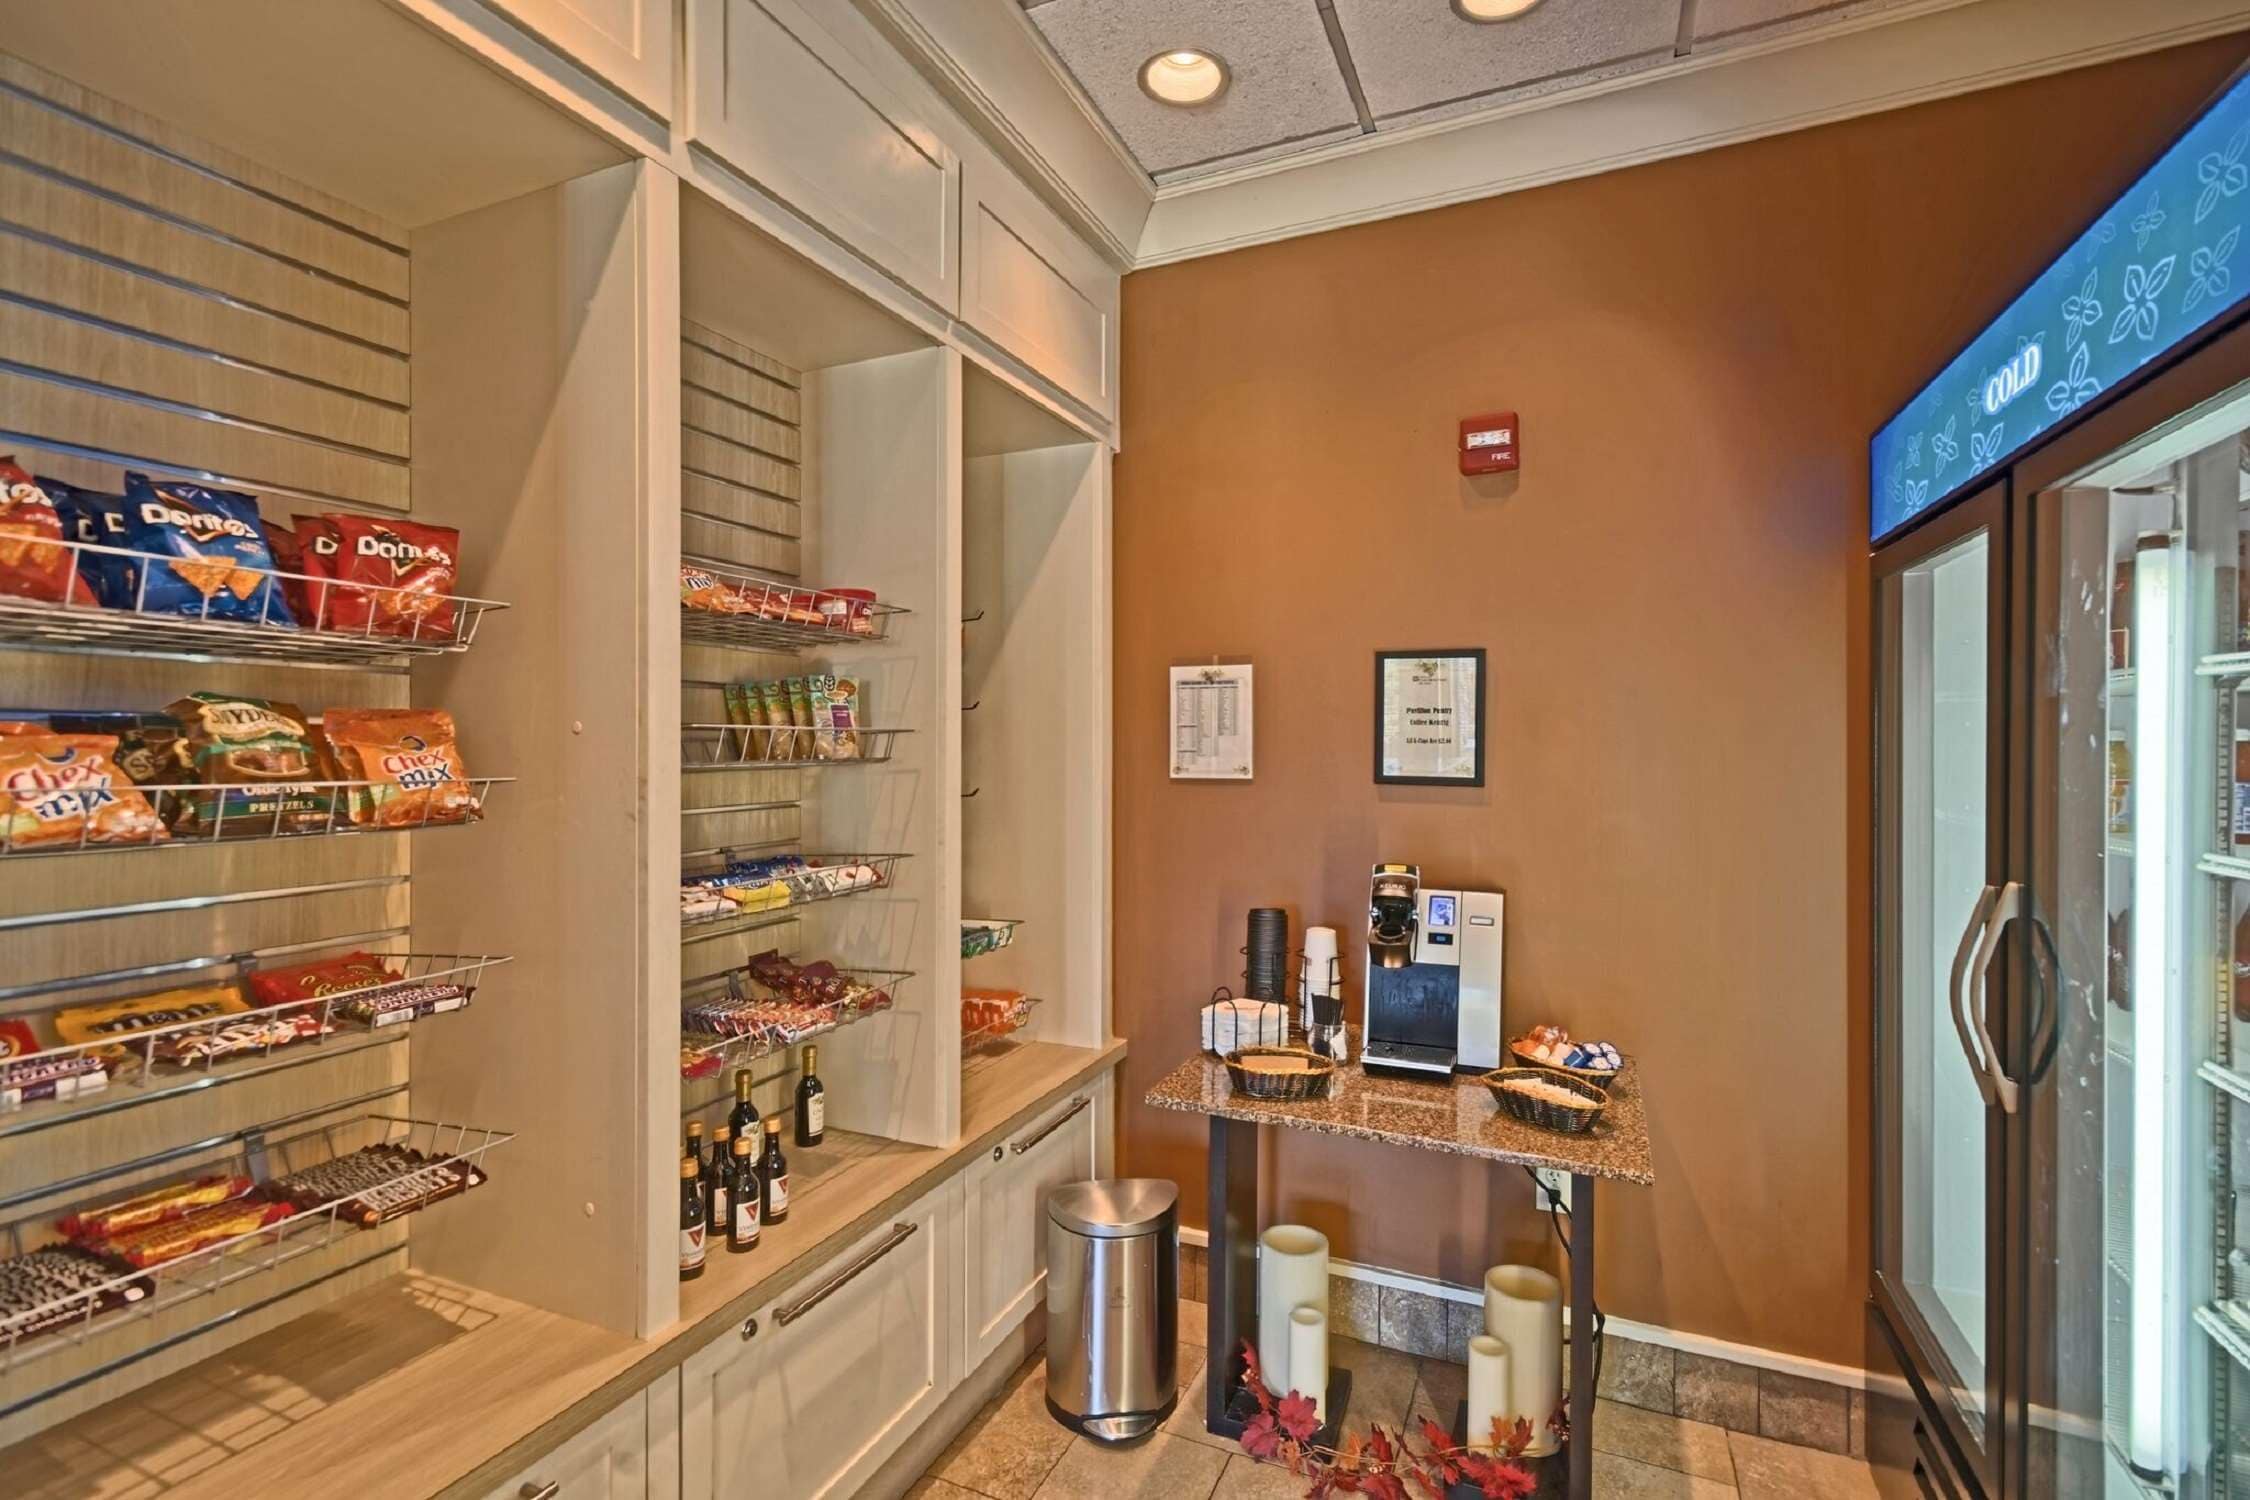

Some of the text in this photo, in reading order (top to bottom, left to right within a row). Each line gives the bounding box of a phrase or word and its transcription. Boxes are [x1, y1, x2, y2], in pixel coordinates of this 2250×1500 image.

[1986, 346, 2041, 413] COLD
[140, 503, 259, 538] Doritos
[357, 536, 452, 565] Doritos
[383, 749, 446, 774] Chex
[399, 763, 452, 790] mix
[8, 757, 102, 801] Chex
